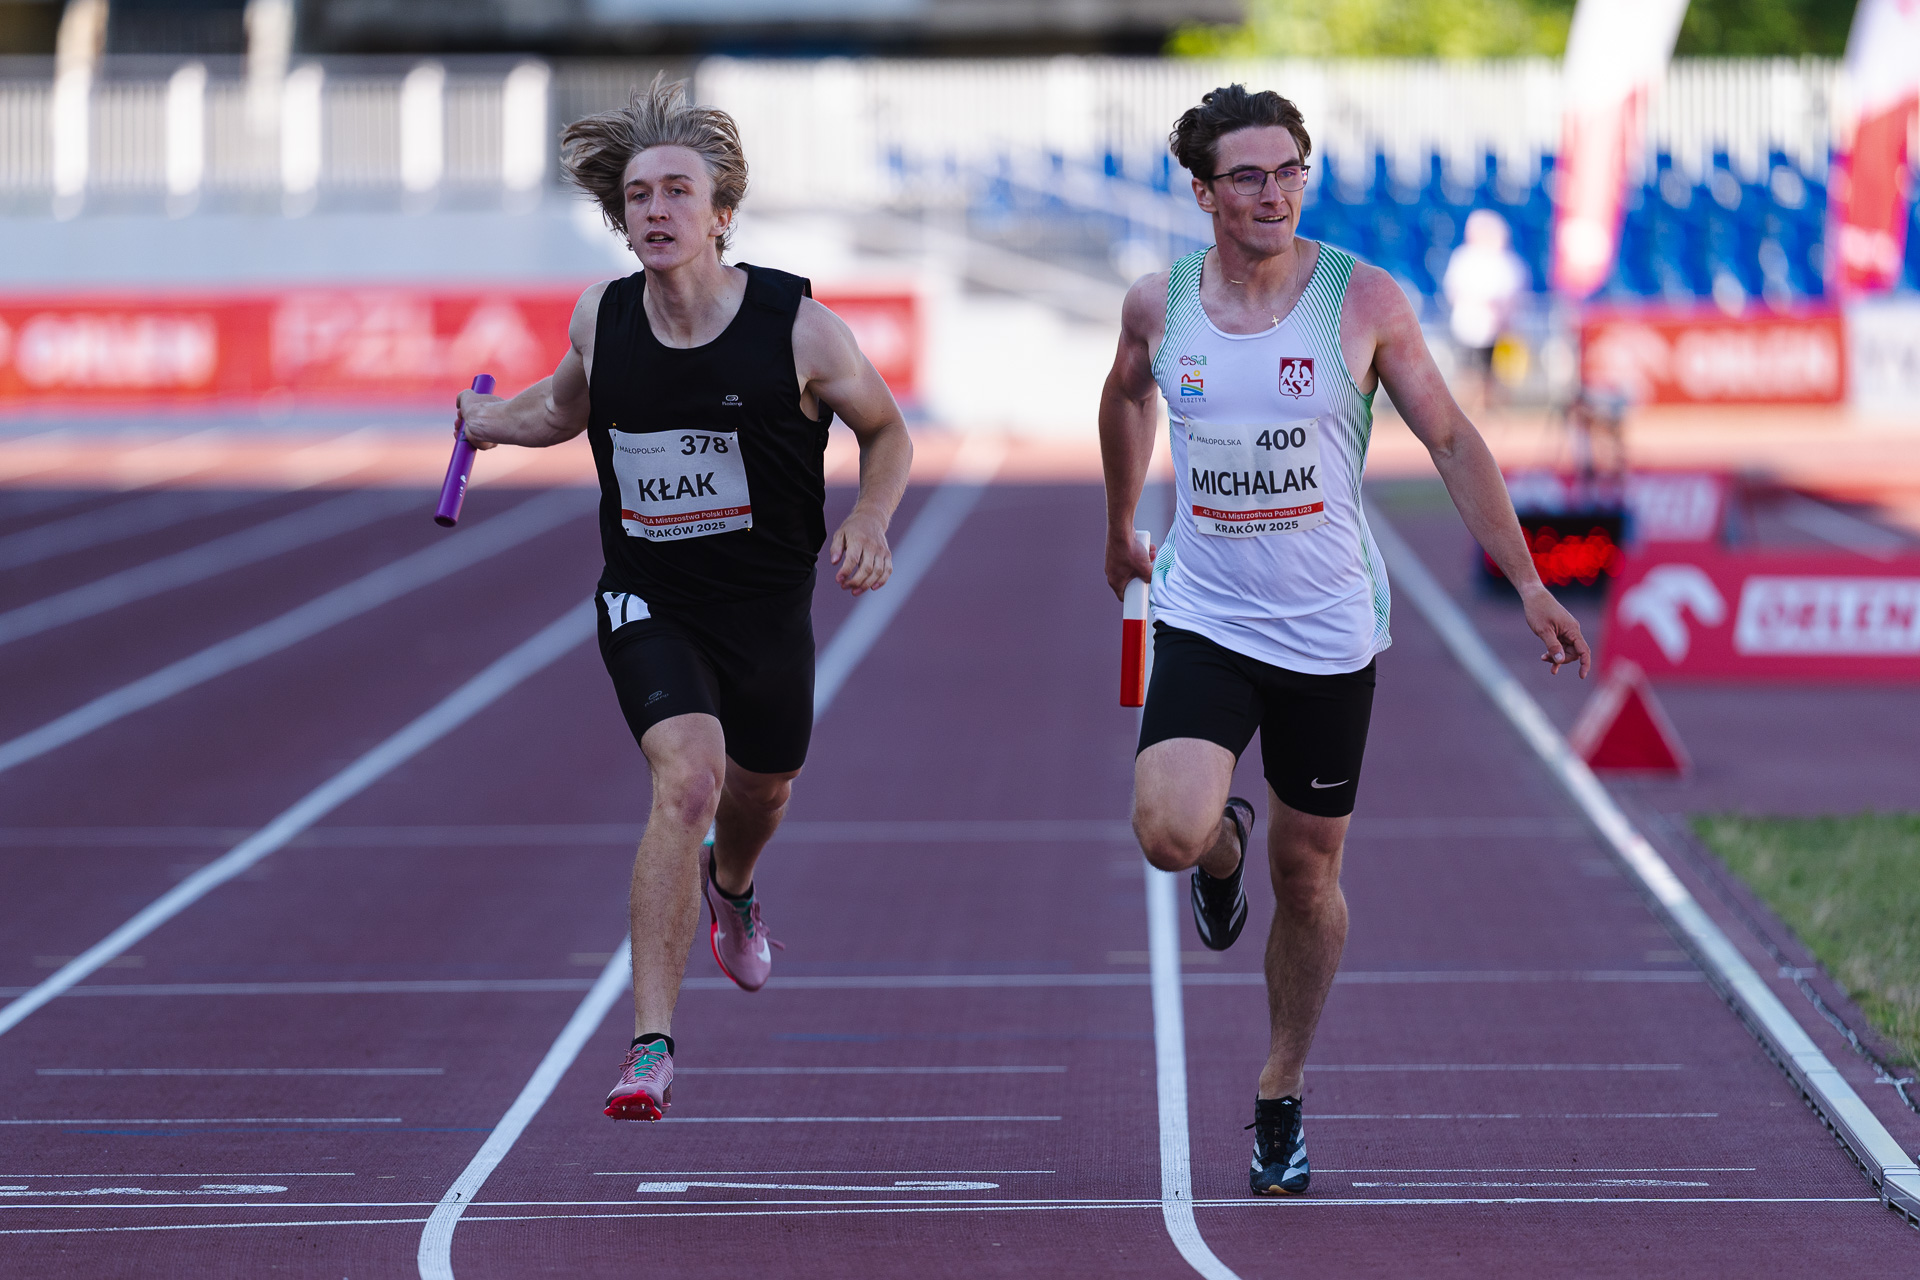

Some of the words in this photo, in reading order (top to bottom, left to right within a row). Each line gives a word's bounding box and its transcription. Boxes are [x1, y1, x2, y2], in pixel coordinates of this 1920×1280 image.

[680, 435, 729, 456] 378
[1196, 435, 1242, 446] MAŁOPOLSKA
[1256, 427, 1306, 451] 400
[619, 445, 666, 455] MAŁOPOLSKA
[638, 471, 718, 502] KŁAK
[1192, 465, 1318, 496] MICHALAK
[655, 513, 700, 525] Mistrzostwa
[701, 509, 723, 519] Polski
[724, 508, 739, 516] U23
[1212, 511, 1227, 519] PZLA
[1228, 510, 1273, 520] Mistrzostwa
[1274, 509, 1297, 518] Polski
[1298, 505, 1312, 514] U23
[644, 524, 693, 538] KRAKÓW
[697, 521, 726, 532] 2025
[1215, 522, 1266, 534] KRAKÓW
[1269, 520, 1299, 532] 2025
